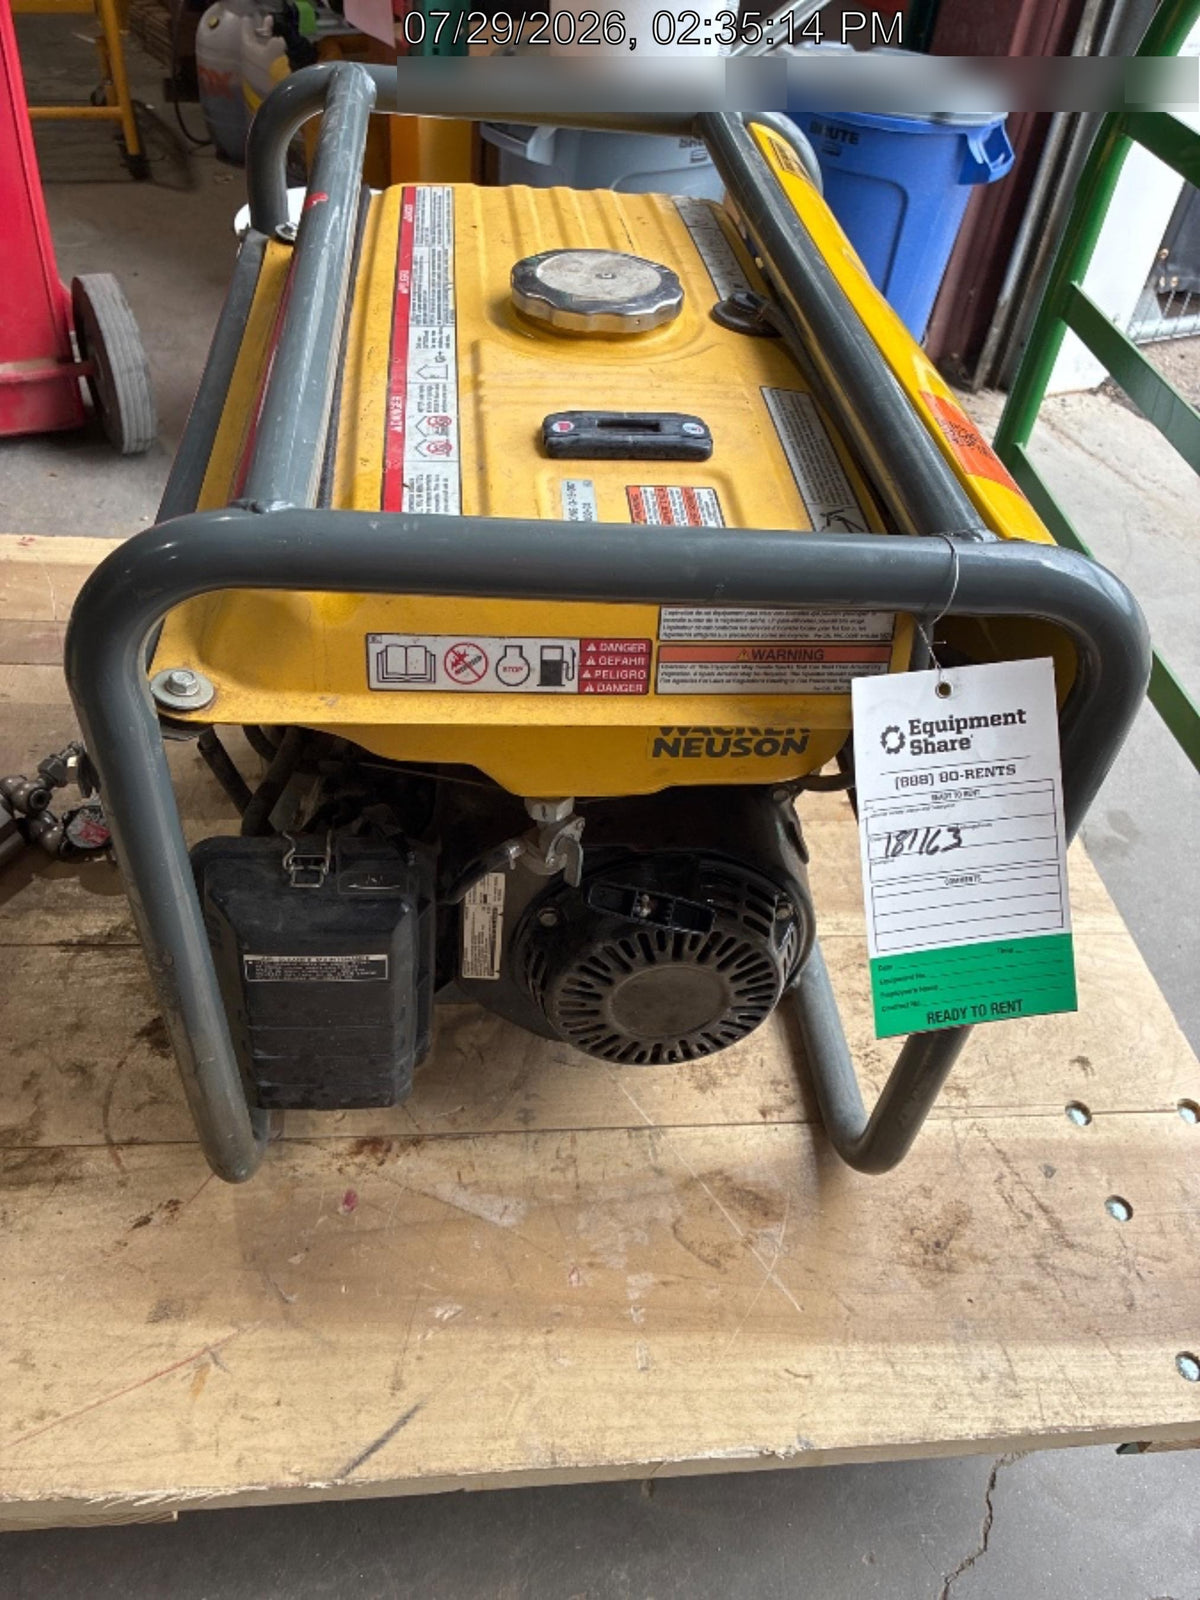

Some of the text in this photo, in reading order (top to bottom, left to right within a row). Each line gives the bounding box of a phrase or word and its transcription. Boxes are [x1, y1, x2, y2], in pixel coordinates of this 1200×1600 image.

[600, 642, 646, 653] DANGER
[598, 656, 646, 666] GEFAHR
[752, 649, 825, 661] WARNING
[594, 669, 647, 680] PELIGRO
[597, 682, 644, 693] DANGER
[908, 709, 1027, 737] Equipment
[652, 736, 810, 758] NEUSON
[909, 737, 972, 756] Share
[926, 999, 1024, 1025] READY TO RENT
